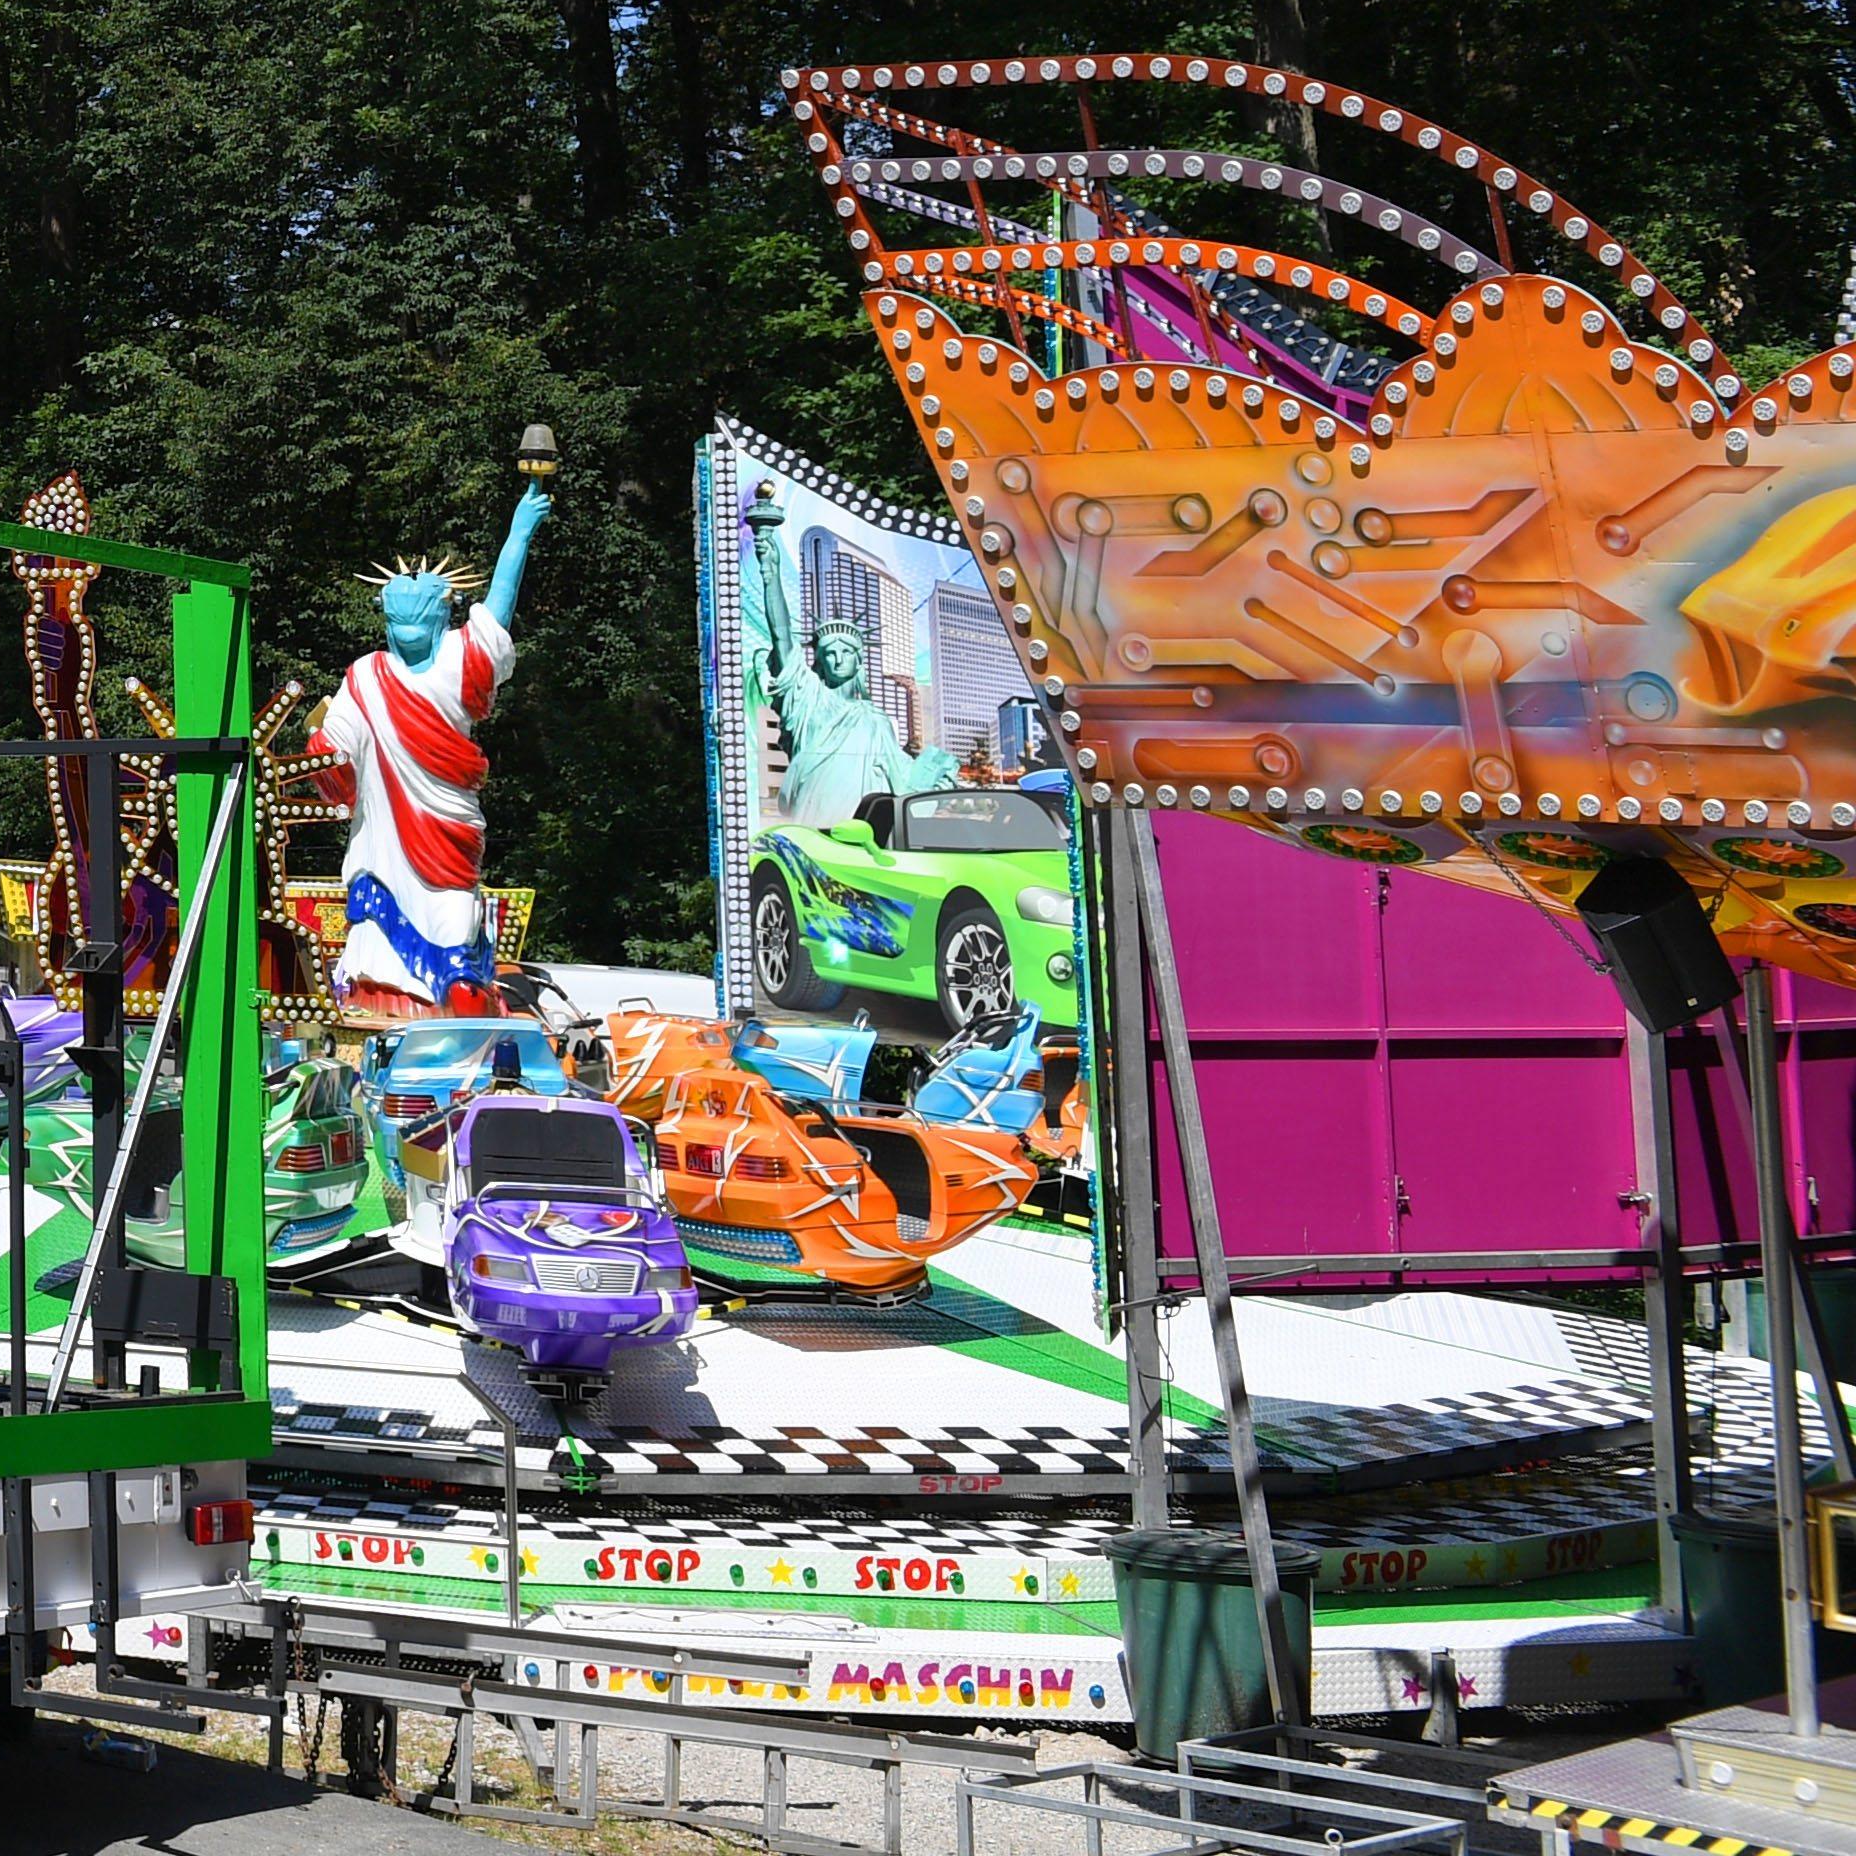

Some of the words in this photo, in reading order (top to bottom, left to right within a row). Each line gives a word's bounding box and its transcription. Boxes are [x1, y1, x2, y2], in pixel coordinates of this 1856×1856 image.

[919, 1475, 1003, 1493] STOP
[598, 1547, 700, 1581] STOP
[1341, 1549, 1427, 1586] STOP
[1546, 1531, 1604, 1572] STOP
[855, 1556, 961, 1591] STOP
[827, 1662, 1074, 1709] MASCHIN
